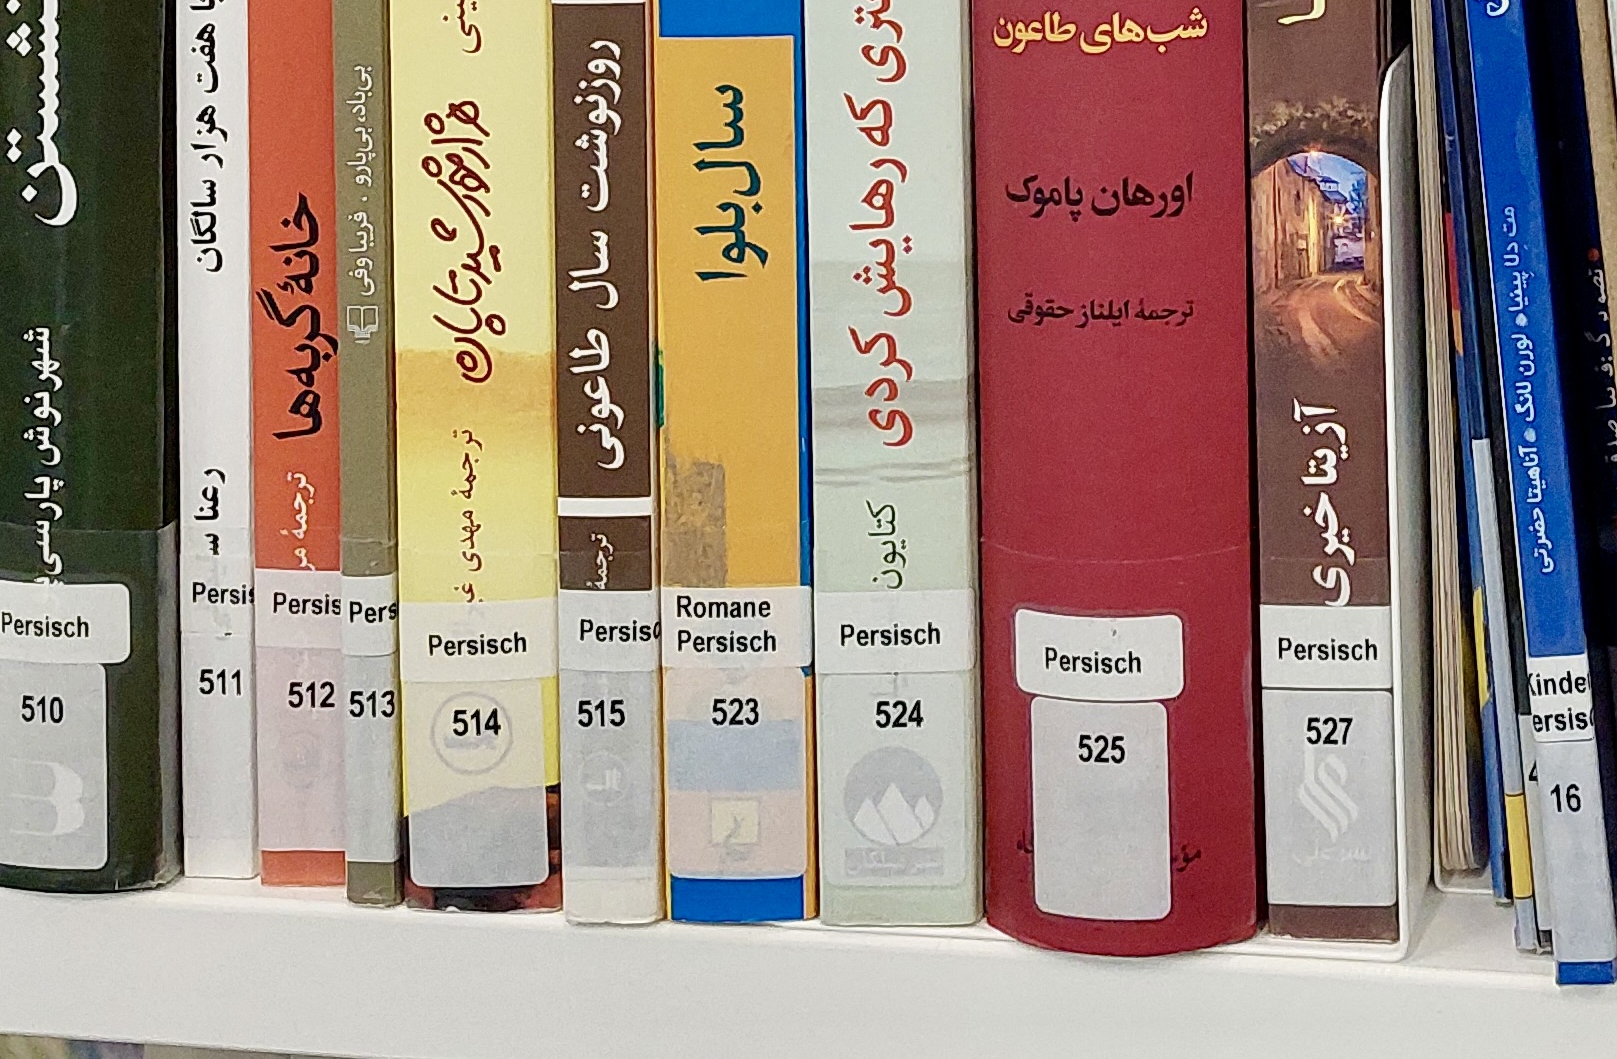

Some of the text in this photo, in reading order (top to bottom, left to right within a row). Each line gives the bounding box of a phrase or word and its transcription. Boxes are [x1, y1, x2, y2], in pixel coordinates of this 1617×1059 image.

[992, 10, 1077, 54] طاعون
[844, 93, 893, 147] که
[191, 104, 227, 167] هزار
[692, 84, 769, 281] سال بلوا
[1005, 171, 1194, 222] اورهان پاموک
[849, 158, 913, 317] رهایش
[567, 40, 625, 470] روزنوشت سال طاعونی
[1007, 291, 1131, 329] ایلناز حقوقی
[849, 325, 913, 447] کردی
[1293, 397, 1356, 606] آزیتا خیری
[865, 500, 908, 590] کتایون
[676, 595, 771, 618] Romane
[1, 613, 89, 638] Persisch
[840, 623, 941, 647] Persisch
[428, 632, 527, 657] Persisch
[677, 630, 777, 654] Persisch
[1278, 638, 1378, 661] Persisch
[1045, 647, 1142, 675] Persisch
[198, 669, 242, 696] 511
[288, 682, 335, 709] 512
[21, 696, 64, 723] 510
[349, 690, 395, 718] 513
[578, 700, 625, 728] 515
[711, 697, 760, 726] 523
[875, 699, 923, 728] 524
[452, 708, 500, 737] 514
[1306, 717, 1353, 746] 527
[1078, 734, 1126, 764] 525
[1551, 785, 1581, 812] 16
